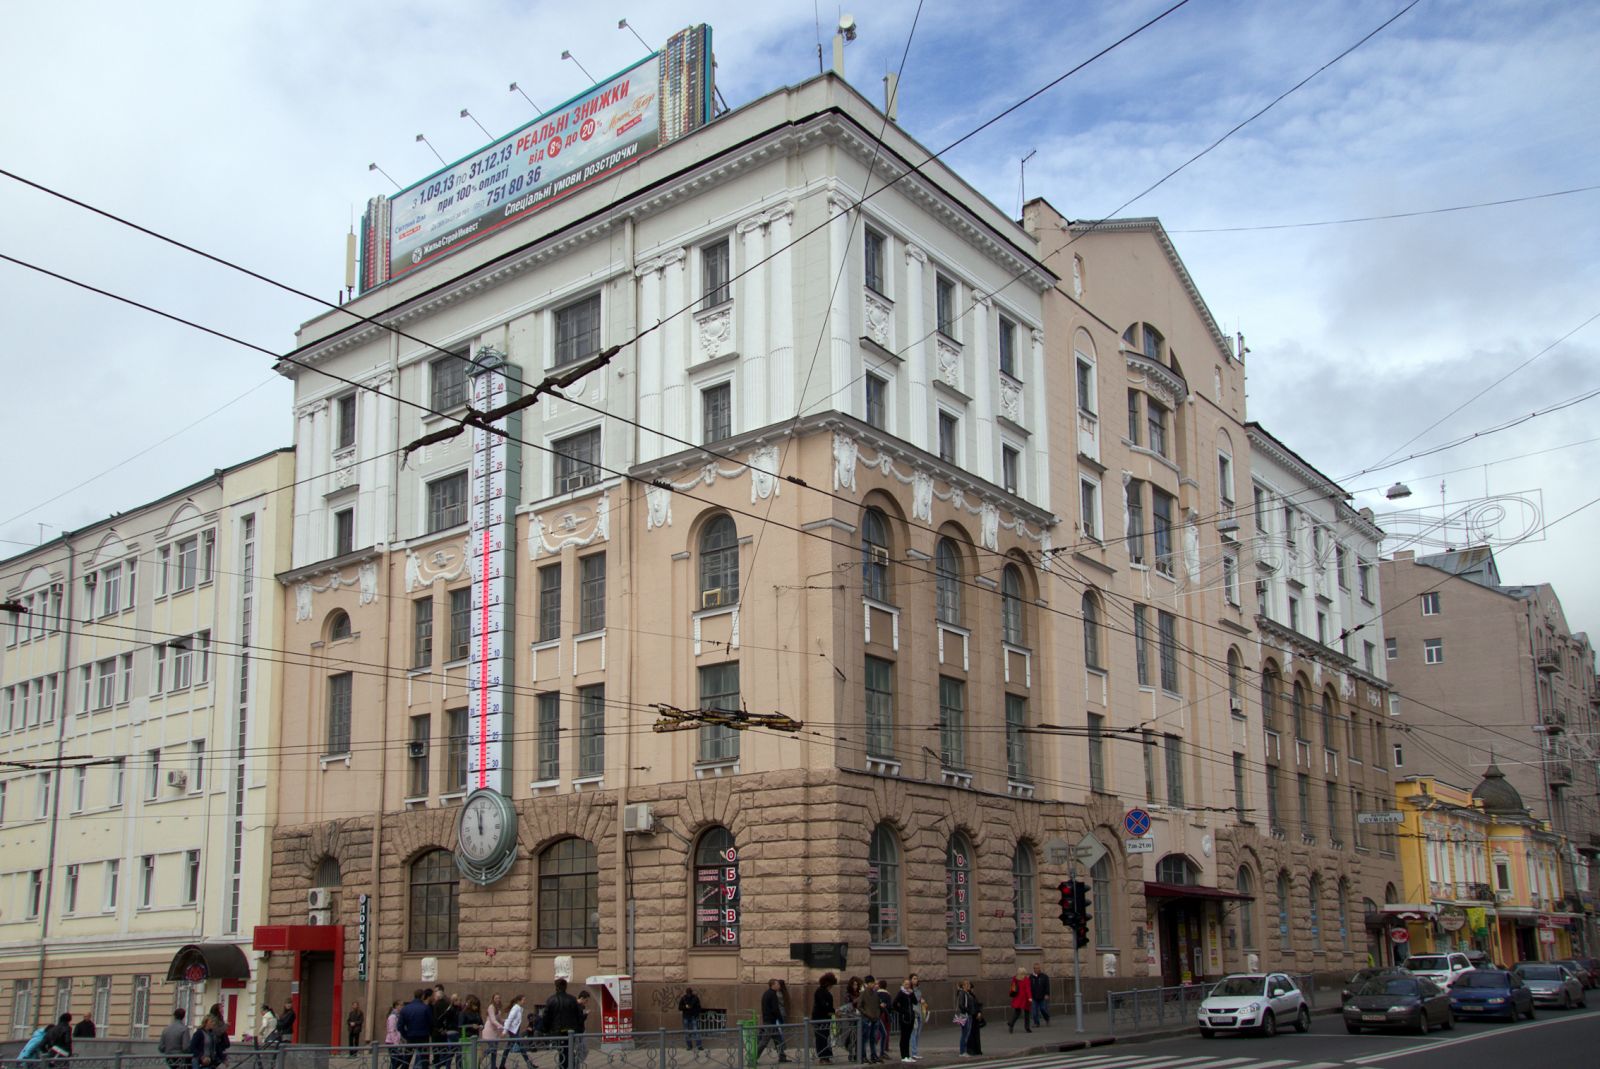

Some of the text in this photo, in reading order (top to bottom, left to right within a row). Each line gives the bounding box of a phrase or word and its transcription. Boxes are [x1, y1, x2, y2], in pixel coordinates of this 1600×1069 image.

[515, 114, 568, 155] РЕАЛЬНІ
[572, 80, 630, 125] ЗНИЖКИ
[528, 147, 544, 165] від
[564, 131, 578, 148] до
[419, 174, 455, 205] 1.09.13
[456, 174, 467, 185] по
[469, 144, 513, 179] 31.12.13
[505, 142, 638, 217] Спеціальні умови розстрочки
[437, 197, 453, 213] при
[478, 165, 510, 191] оплаті
[486, 185, 506, 207] 751
[508, 175, 524, 195] 80
[526, 166, 542, 187] 36
[496, 461, 503, 470] 25
[496, 488, 502, 497] 20
[496, 515, 502, 523] 15
[496, 541, 501, 549] 10
[494, 649, 500, 657] 10
[493, 676, 499, 685] 15
[493, 704, 499, 712] 20
[492, 731, 499, 740] 25
[492, 759, 499, 768] 30
[726, 848, 737, 941] ОБУВЬ
[956, 854, 967, 942] ОБУВЬ
[358, 905, 366, 973] ЛОМБАРД
